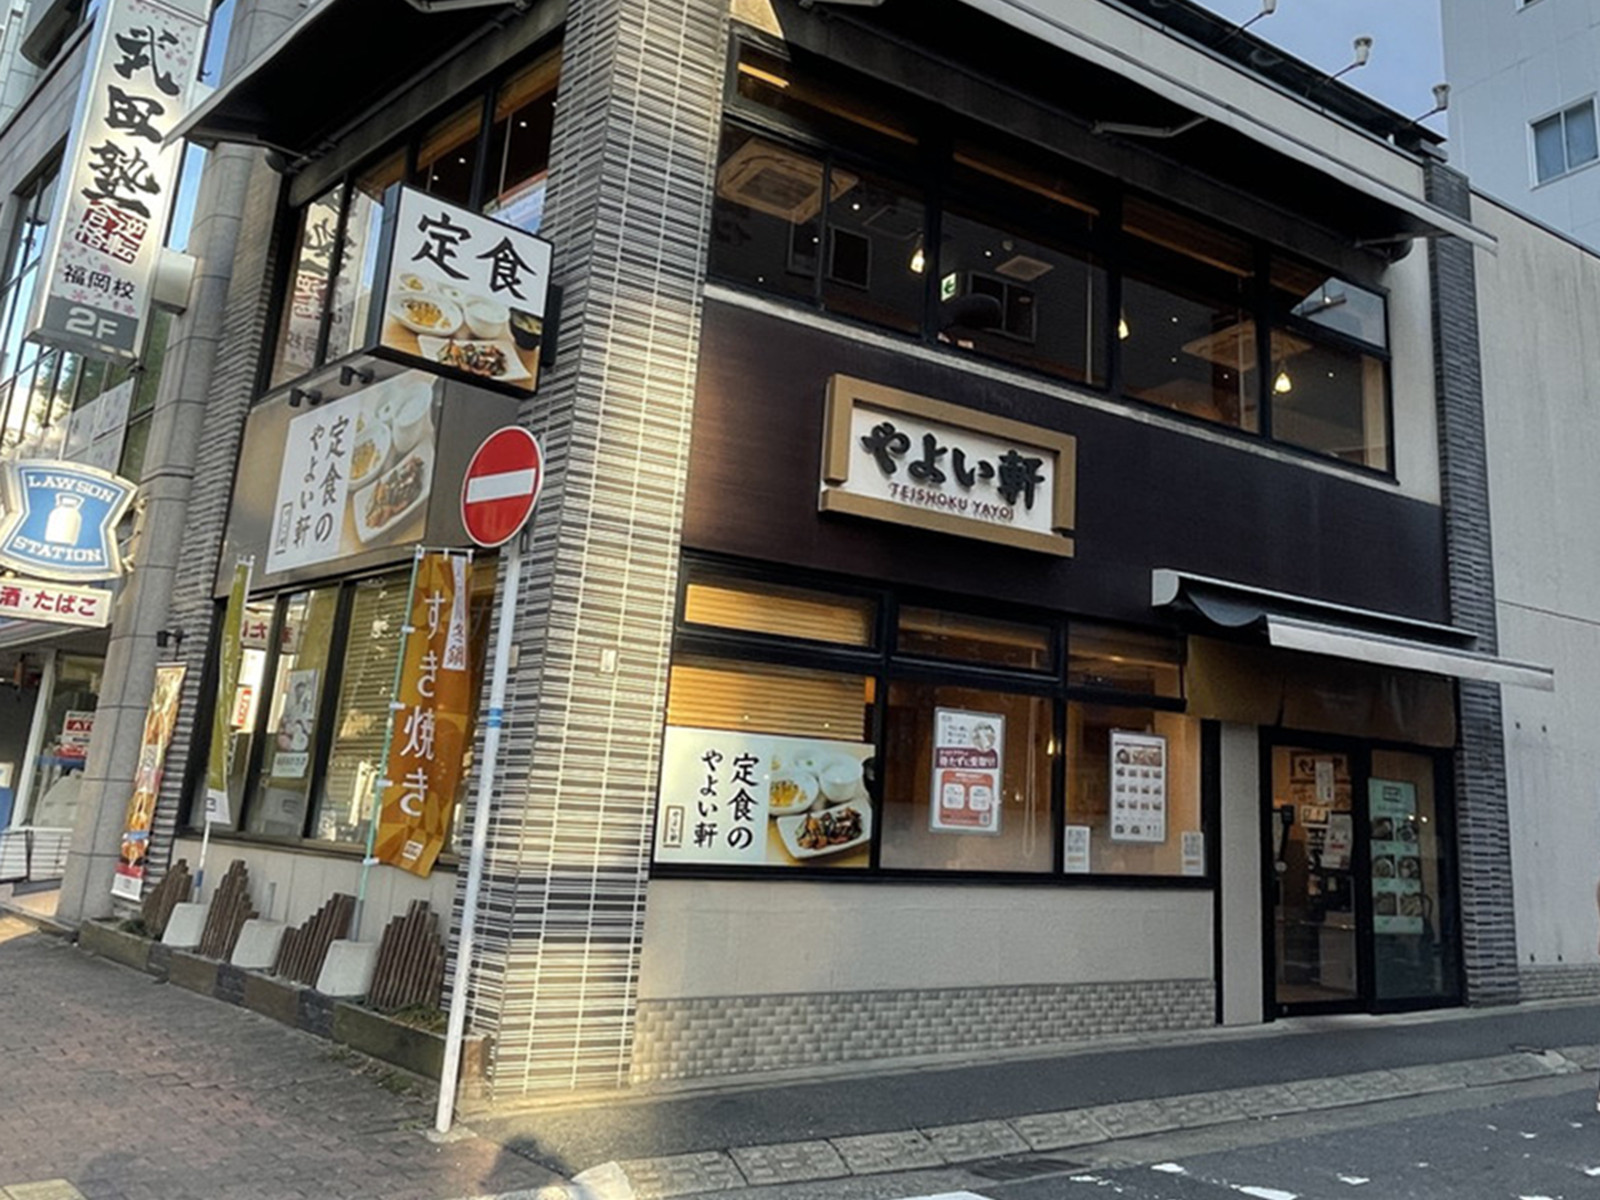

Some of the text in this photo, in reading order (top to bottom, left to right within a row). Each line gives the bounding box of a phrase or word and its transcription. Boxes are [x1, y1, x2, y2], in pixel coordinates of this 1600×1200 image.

[82, 25, 181, 219] 武田塾
[63, 264, 136, 301] 福岡校
[411, 212, 537, 301] 定食
[65, 307, 120, 340] 2F
[28, 474, 115, 503] LAWSON
[293, 424, 324, 549] やよい軒
[315, 415, 350, 543] 定食の
[861, 422, 1045, 510] やよい軒
[889, 483, 1014, 521] TEISHOKU YAYOI
[13, 536, 103, 562] STATION
[399, 590, 447, 817] すき焼き
[693, 749, 724, 849] やよい軒
[727, 752, 760, 850] 定食の
